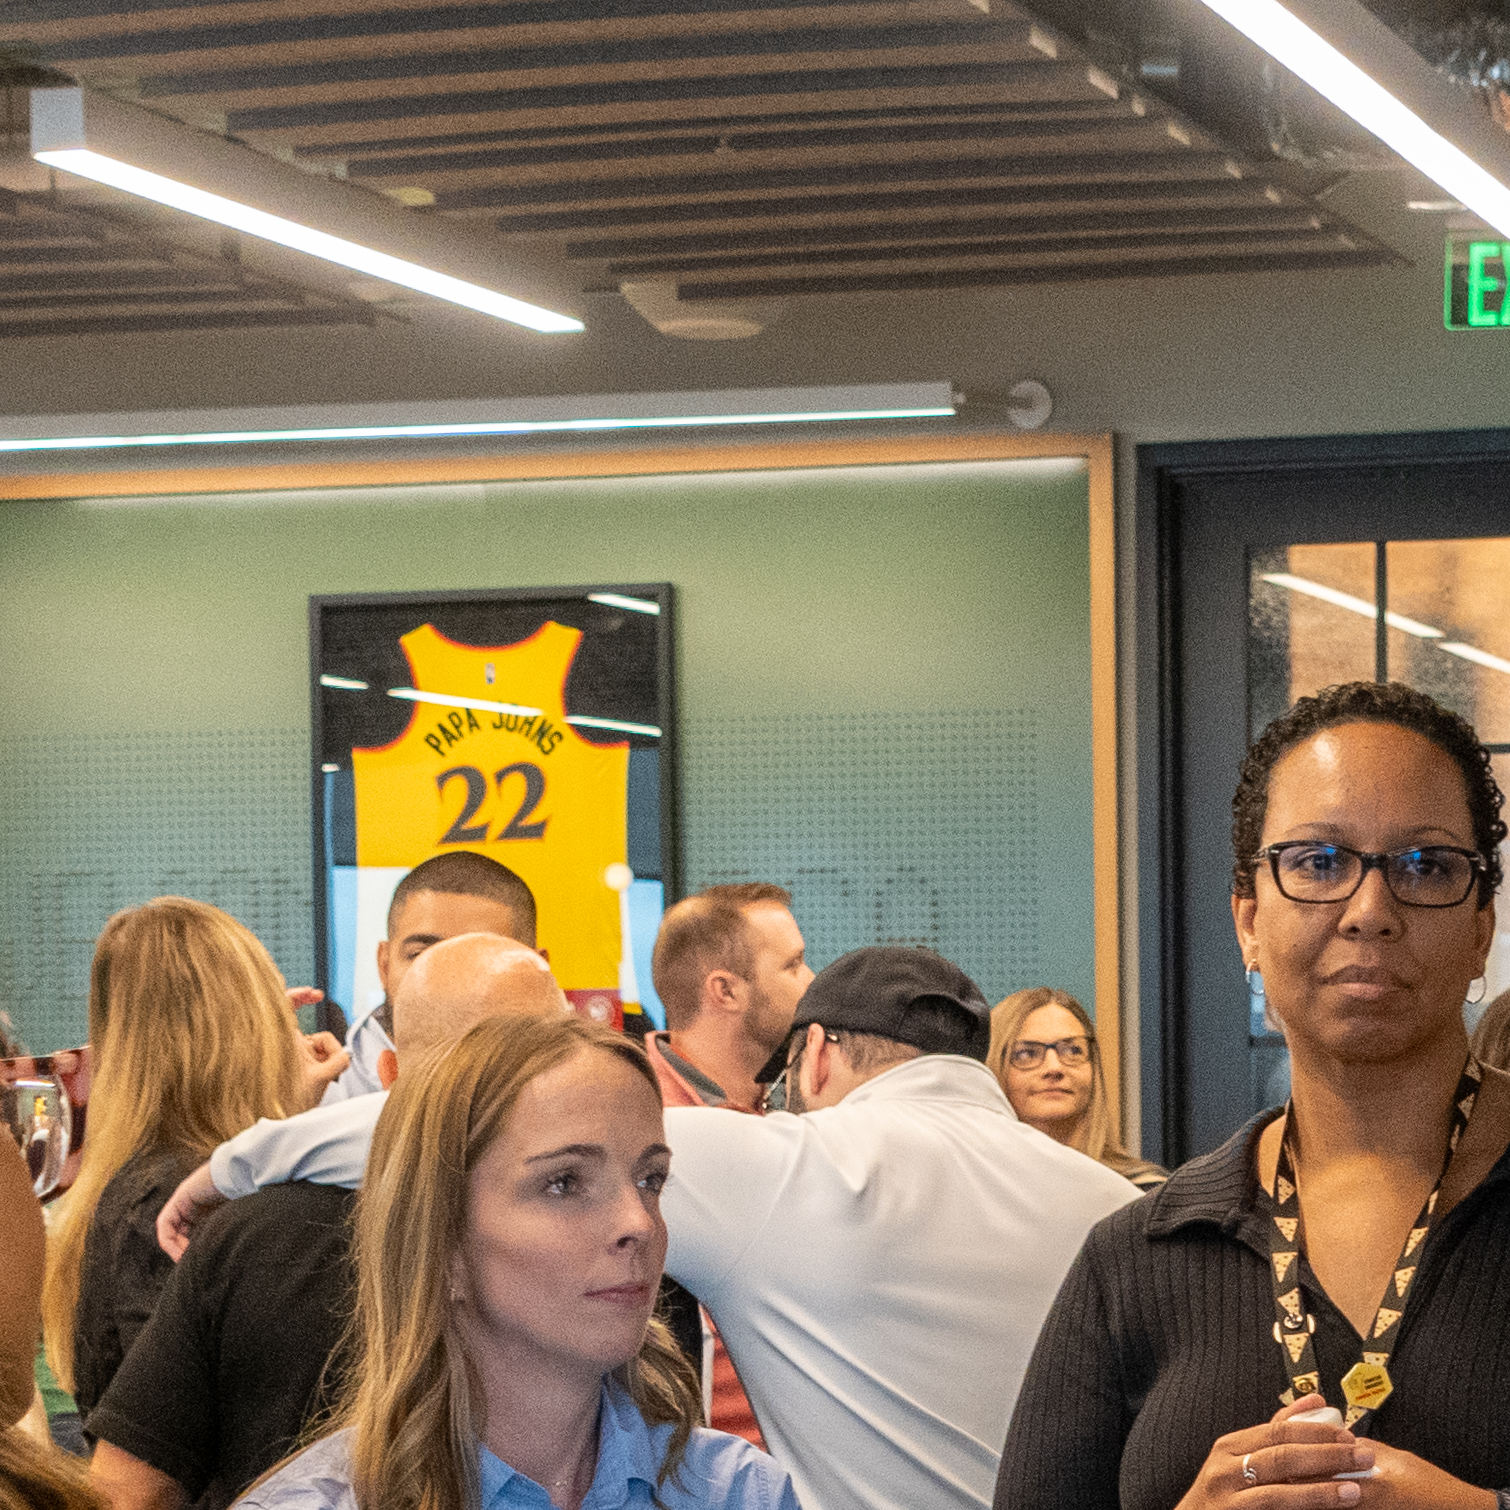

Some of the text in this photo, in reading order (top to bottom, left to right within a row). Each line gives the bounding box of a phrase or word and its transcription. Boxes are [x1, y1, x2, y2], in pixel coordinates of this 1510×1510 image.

[424, 701, 564, 757] PAPA JOHNS
[436, 762, 551, 848] 22
